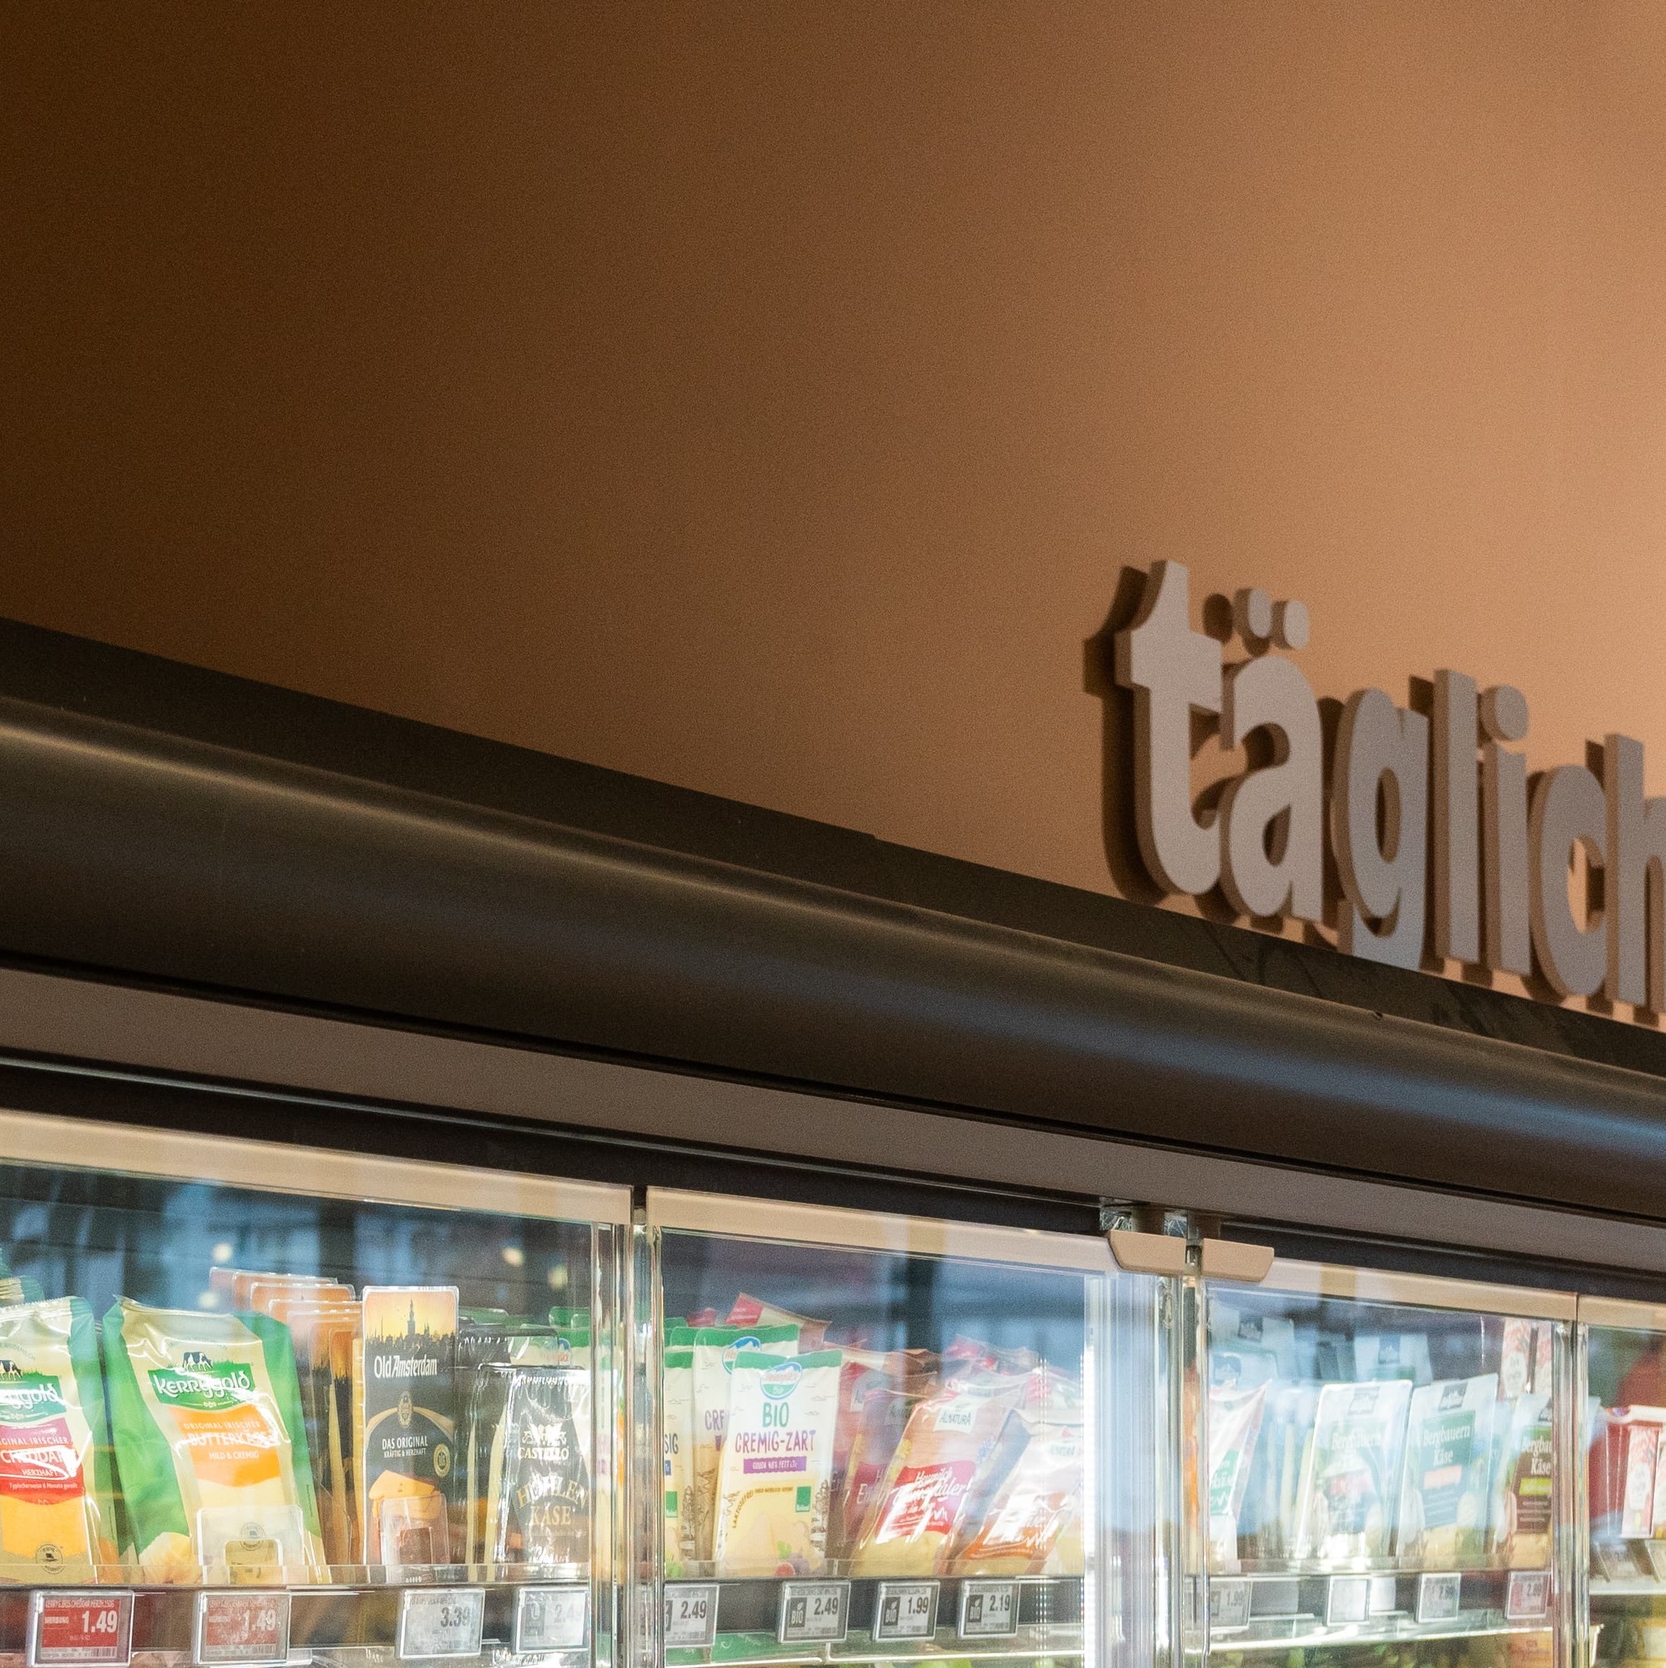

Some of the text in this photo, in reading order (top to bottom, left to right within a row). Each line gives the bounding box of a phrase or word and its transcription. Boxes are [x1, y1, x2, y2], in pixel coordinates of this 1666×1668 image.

[374, 1356, 438, 1378] Old Amsterdam
[762, 1402, 789, 1428] BIO
[939, 1412, 972, 1426] ALNATURA
[29, 1436, 69, 1446] IRISCHER
[382, 1436, 428, 1449] DAS ORIGINAL
[735, 1431, 816, 1453] CREMIG-ZART
[1423, 1422, 1470, 1447] Bergbauern
[1433, 1447, 1453, 1466] Käse
[681, 1600, 707, 1620] 2.49
[790, 1597, 838, 1623] BIO 2.49
[907, 1597, 929, 1614] 1.99
[989, 1595, 1010, 1612] 2.19
[82, 1610, 118, 1633] 1.49
[441, 1606, 471, 1627] 3.39
